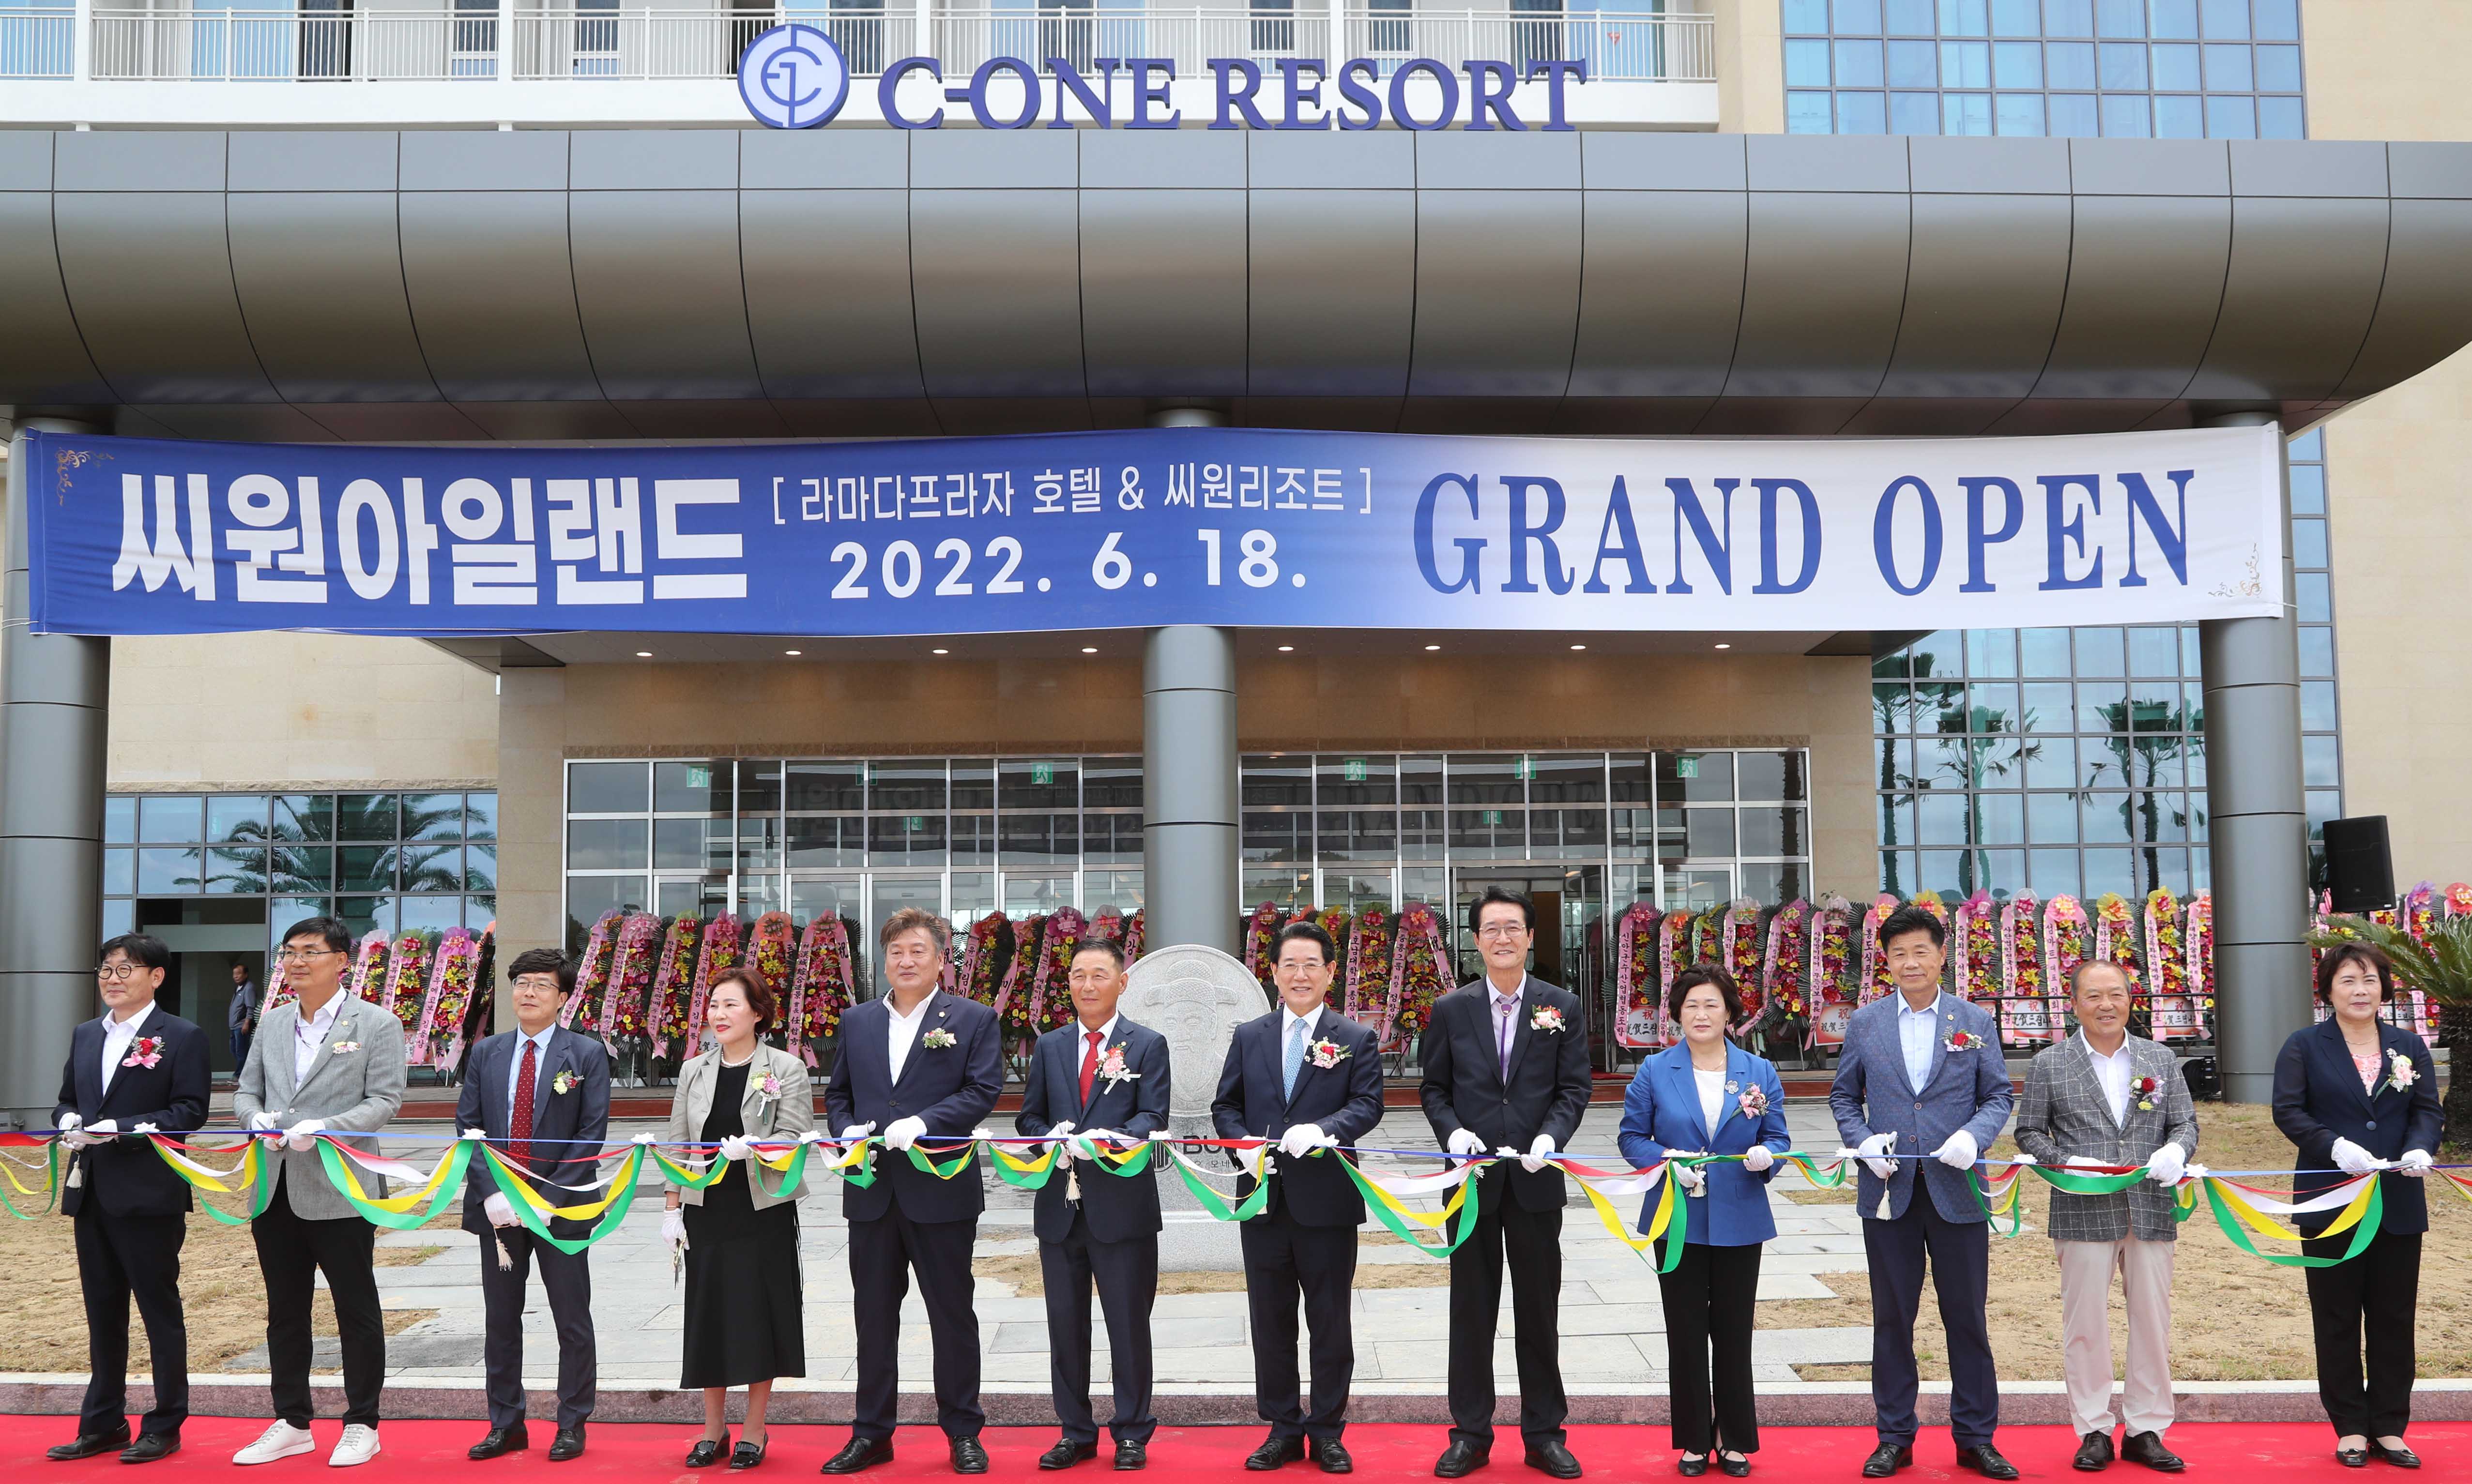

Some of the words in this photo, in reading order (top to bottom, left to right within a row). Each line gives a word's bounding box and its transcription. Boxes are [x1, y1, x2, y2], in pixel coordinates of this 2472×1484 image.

[877, 57, 1181, 131] C-ONE
[1207, 58, 1587, 132] RESORT
[801, 475, 1015, 521] 라마다프라자
[1032, 468, 1101, 513] 호텔
[1117, 466, 1145, 511] &
[1164, 462, 1345, 512] 씨원리조트
[112, 473, 748, 605] 씨원아일랜드
[1413, 473, 1822, 596] GRAND
[1873, 469, 2196, 597] OPEN
[829, 535, 1051, 599] 2022.
[1091, 531, 1158, 590] 6.
[1198, 529, 1306, 588] 18.
[838, 941, 849, 959] 祝
[1127, 939, 1136, 956] 강
[1347, 936, 1359, 986] 호남대학교
[1394, 934, 1407, 971] 중흥그룹
[1862, 928, 1874, 976] 홍도식품
[1957, 925, 1966, 959] 주식회사
[2045, 923, 2058, 960] 섬마트
[267, 959, 284, 1005] 광주농협
[1347, 990, 1357, 1012] 총장
[1616, 932, 1630, 1037] 신안군수산업협동조합
[1642, 1009, 1654, 1020] 祝
[2029, 1000, 2039, 1012] 祝
